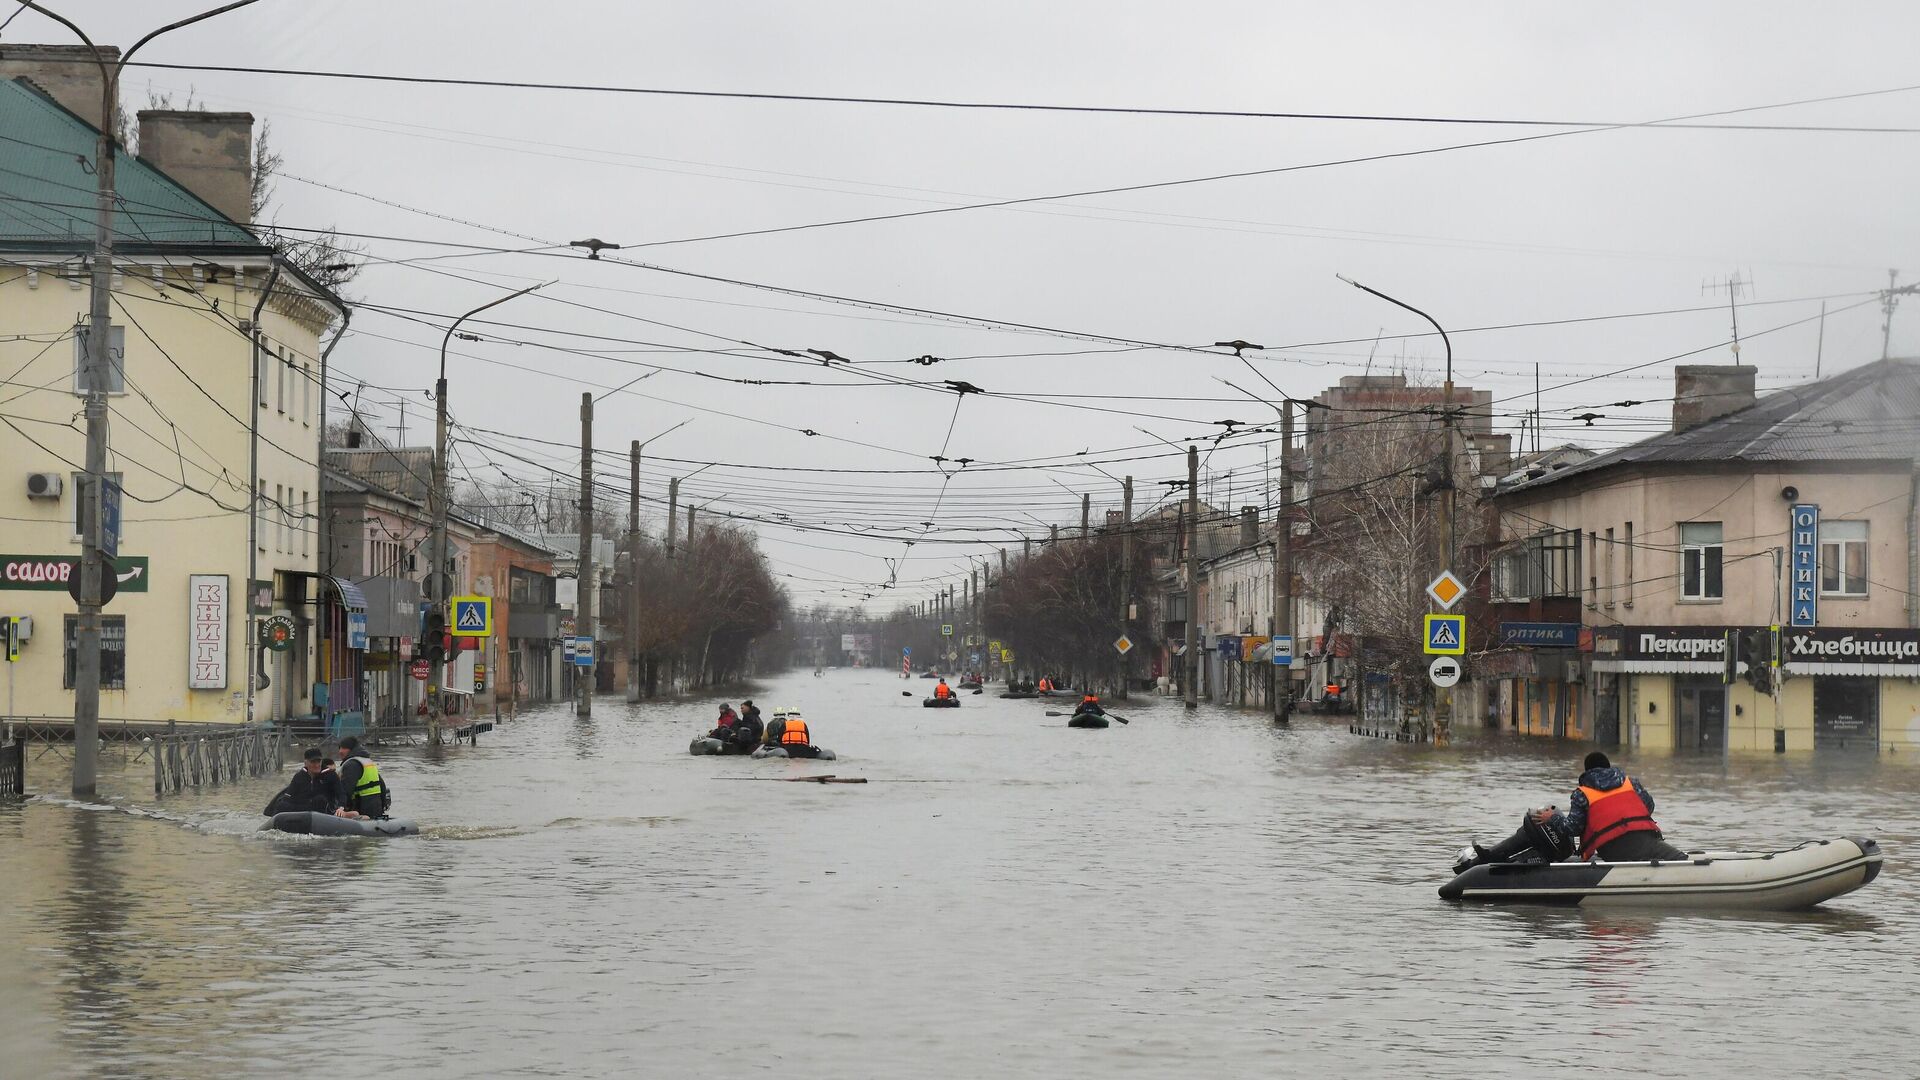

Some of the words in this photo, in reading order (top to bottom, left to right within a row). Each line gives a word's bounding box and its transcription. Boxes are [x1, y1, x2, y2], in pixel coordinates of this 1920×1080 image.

[1797, 513, 1813, 620] ОПТИКА
[196, 585, 220, 680] КНИГИ
[1507, 629, 1564, 639] ОПТИКА
[1640, 634, 1725, 658] Пекарня
[1792, 635, 1918, 659] Хлебница
